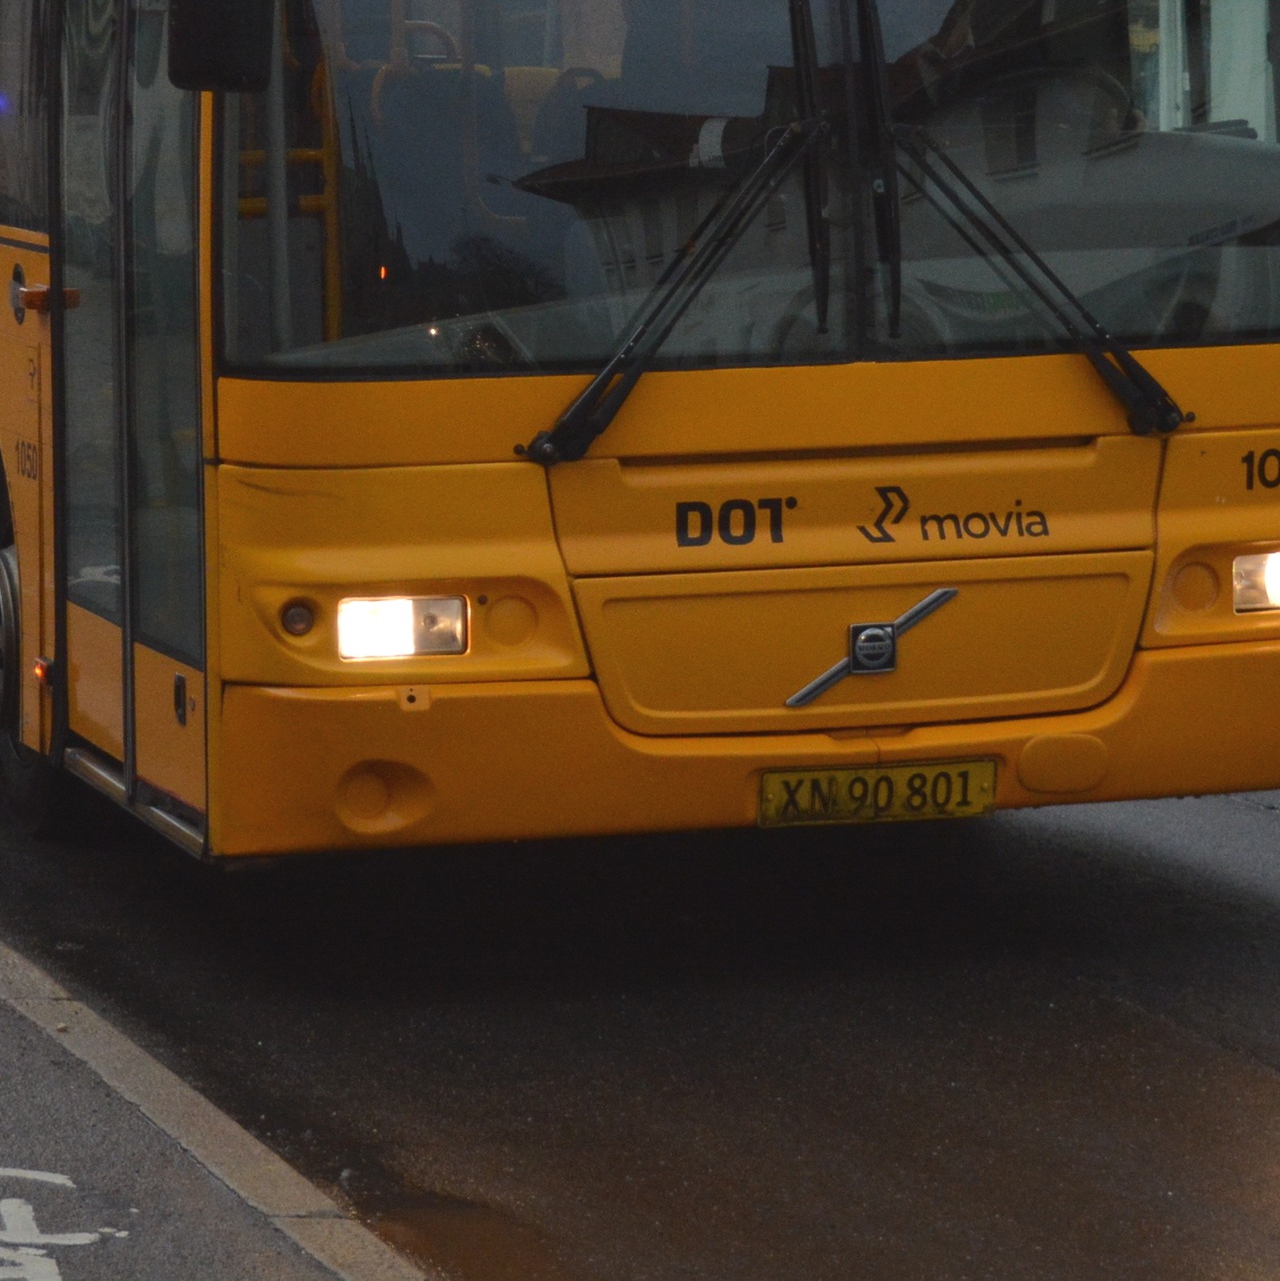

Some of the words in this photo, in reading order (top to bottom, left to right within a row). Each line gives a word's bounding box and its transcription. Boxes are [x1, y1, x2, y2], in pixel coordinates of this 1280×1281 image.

[15, 438, 38, 481] 1050
[675, 497, 790, 548] DOT
[920, 499, 1050, 542] movia
[780, 777, 835, 815] XN
[848, 775, 895, 814] 90
[905, 771, 973, 811] 801
